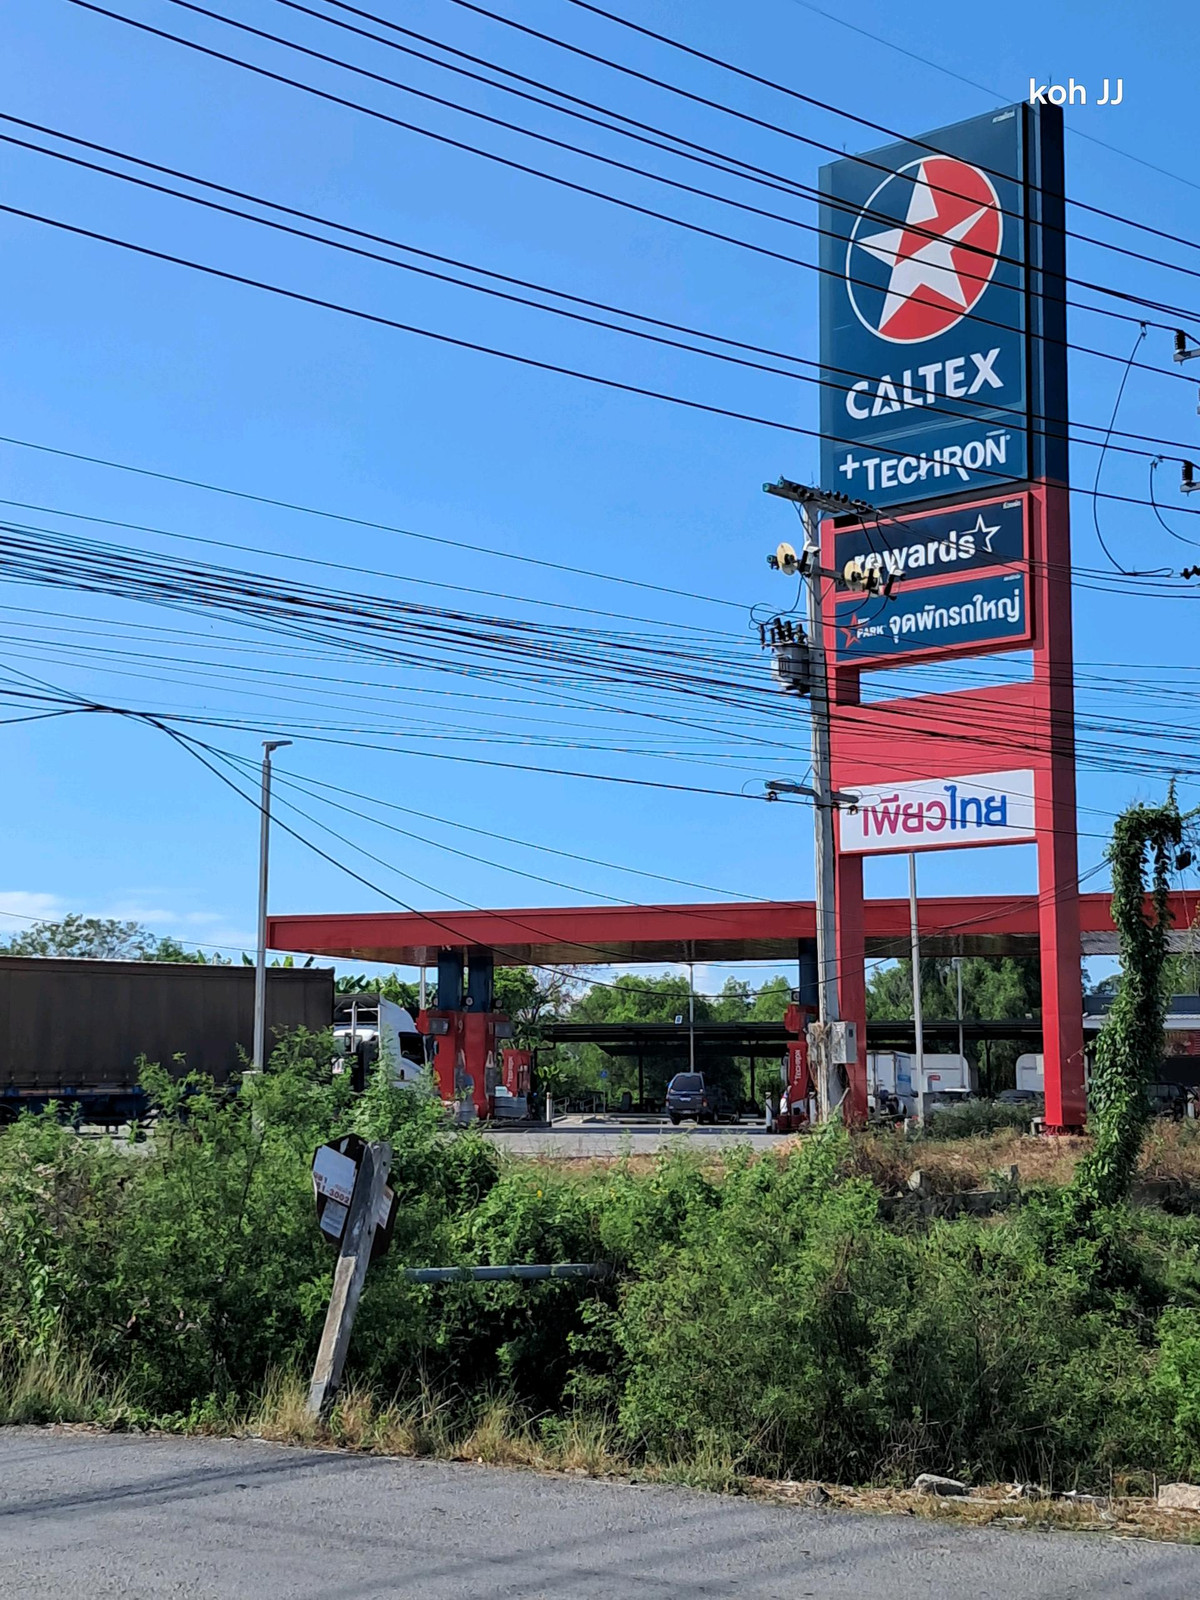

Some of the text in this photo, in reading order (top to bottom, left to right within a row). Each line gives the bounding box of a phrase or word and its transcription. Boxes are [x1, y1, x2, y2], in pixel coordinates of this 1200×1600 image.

[845, 347, 1004, 420] CALTEX
[854, 530, 976, 575] rewards
[856, 625, 885, 639] PARK
[889, 588, 1020, 644] จุดพักรถใหญ่
[863, 784, 1007, 837] เพียวไทย
